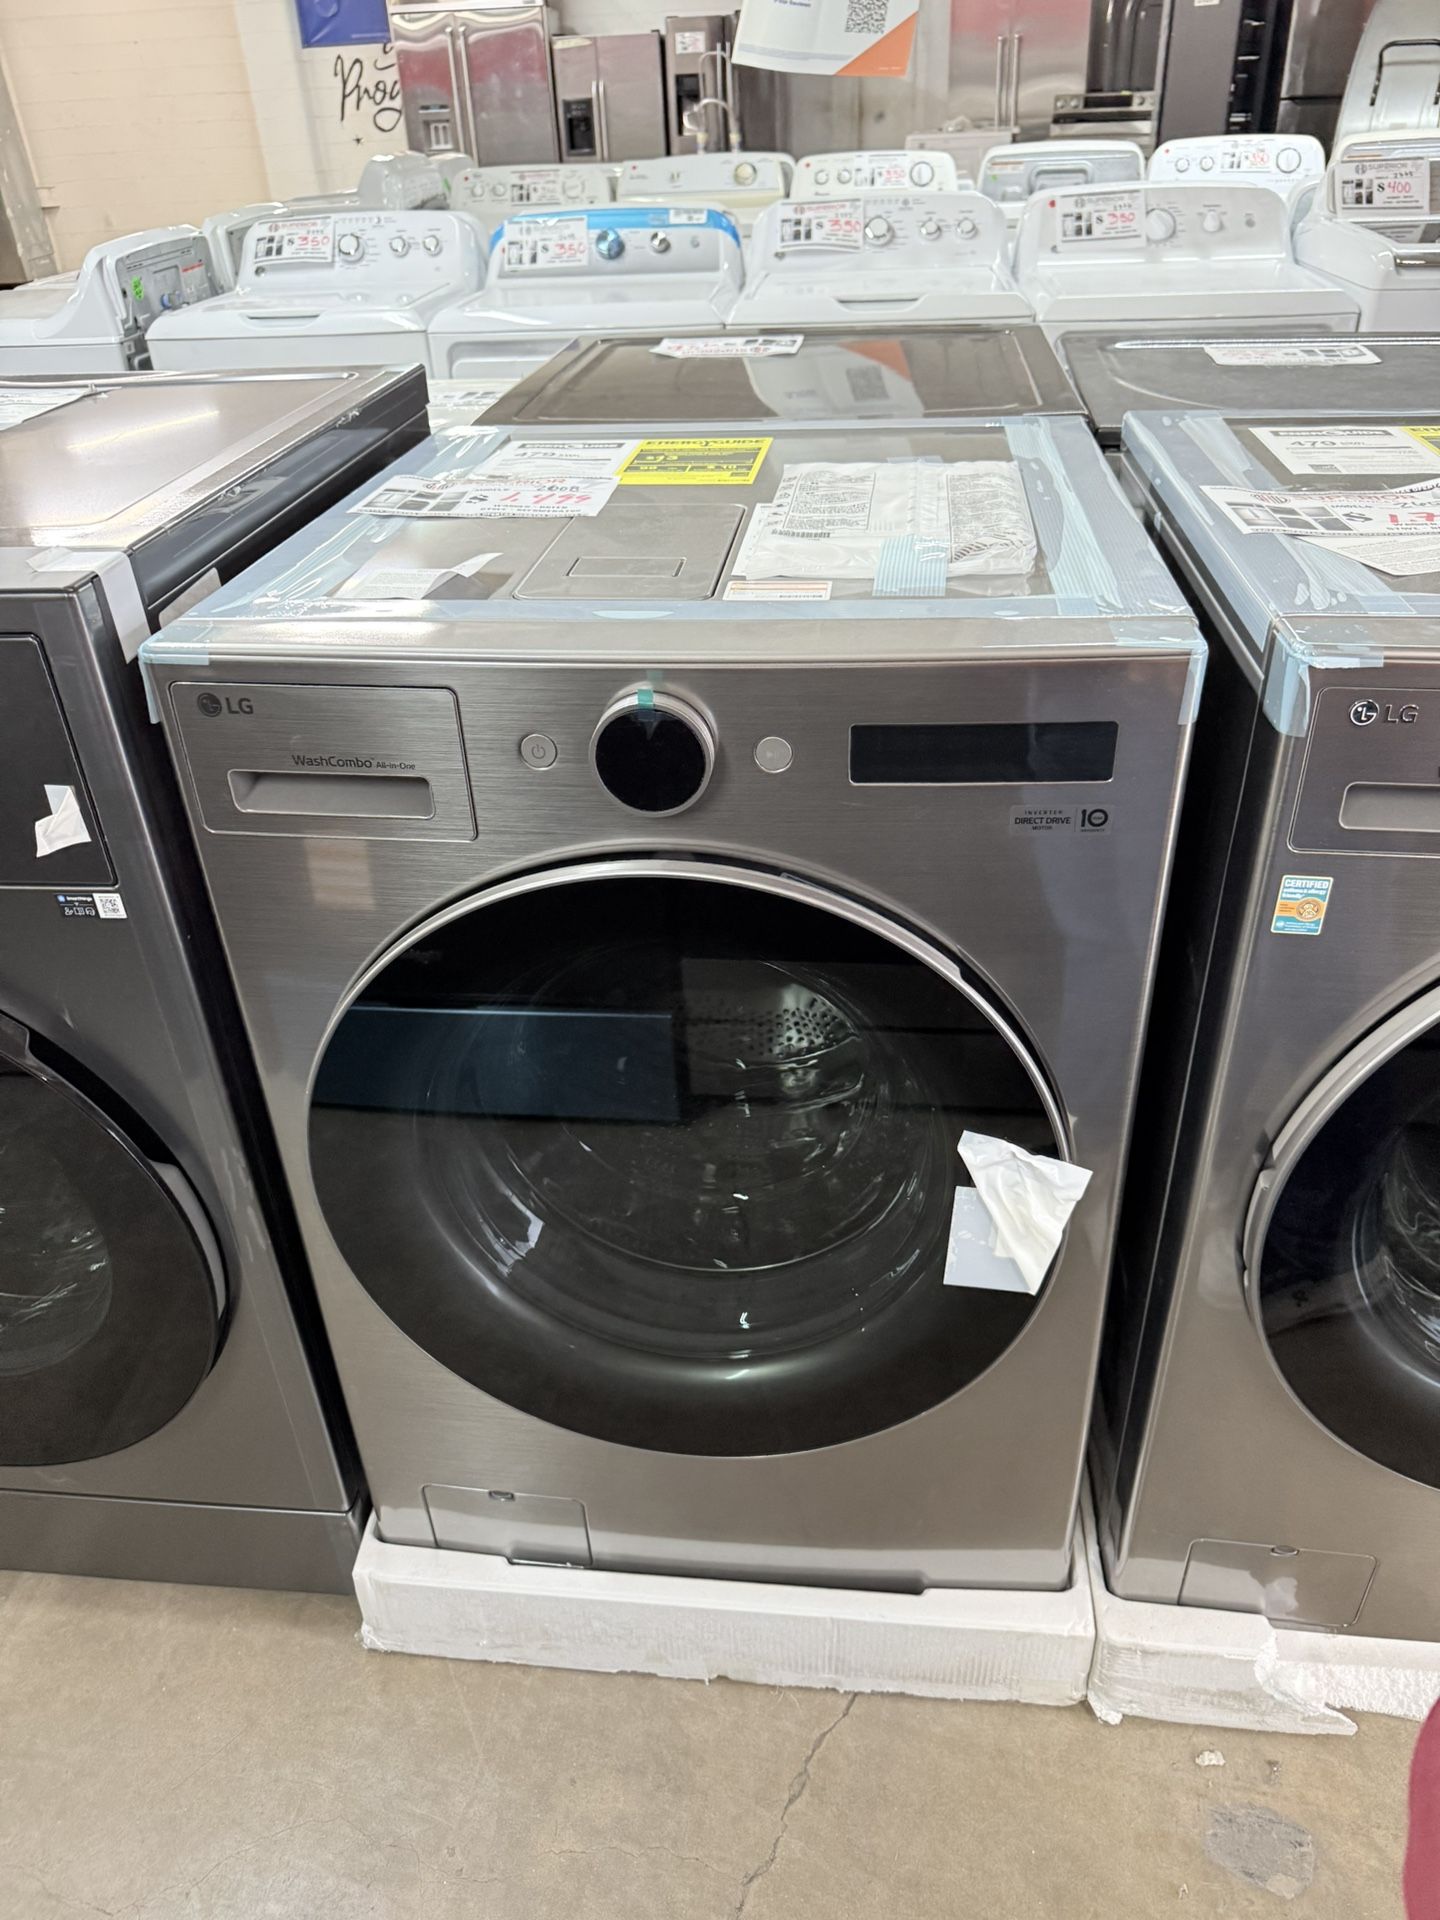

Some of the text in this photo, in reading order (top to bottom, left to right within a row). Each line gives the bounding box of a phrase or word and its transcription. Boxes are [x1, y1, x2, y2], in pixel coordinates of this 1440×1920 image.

[1387, 180, 1412, 193] 400
[1107, 212, 1136, 225] 350
[297, 235, 330, 247] 350
[554, 241, 586, 256] 350
[226, 698, 254, 715] LG
[1384, 703, 1420, 724] LG
[292, 754, 416, 770] WashCombo All-in-One
[1014, 817, 1043, 825] DIRECT
[1045, 817, 1071, 825] DRIVE
[1285, 879, 1330, 889] CERTIFIED
